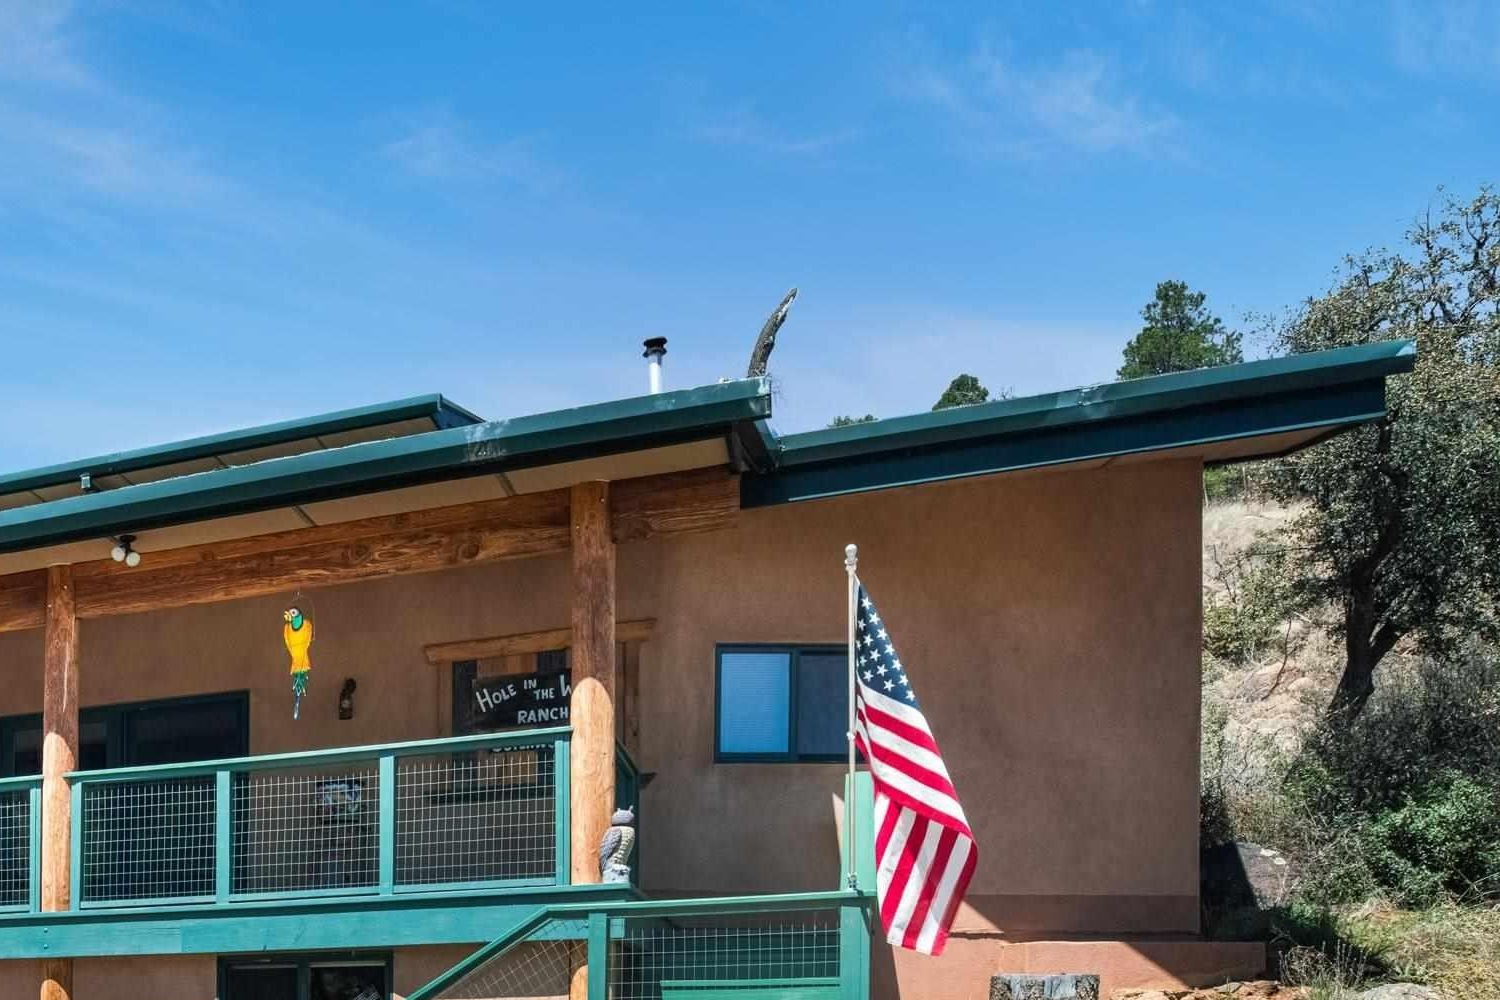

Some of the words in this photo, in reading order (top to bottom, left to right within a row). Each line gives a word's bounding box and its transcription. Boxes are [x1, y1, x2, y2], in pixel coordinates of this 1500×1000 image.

[475, 683, 517, 712] HOLE
[523, 678, 537, 689] IN
[533, 687, 555, 700] THE
[517, 706, 568, 724] RANCH
